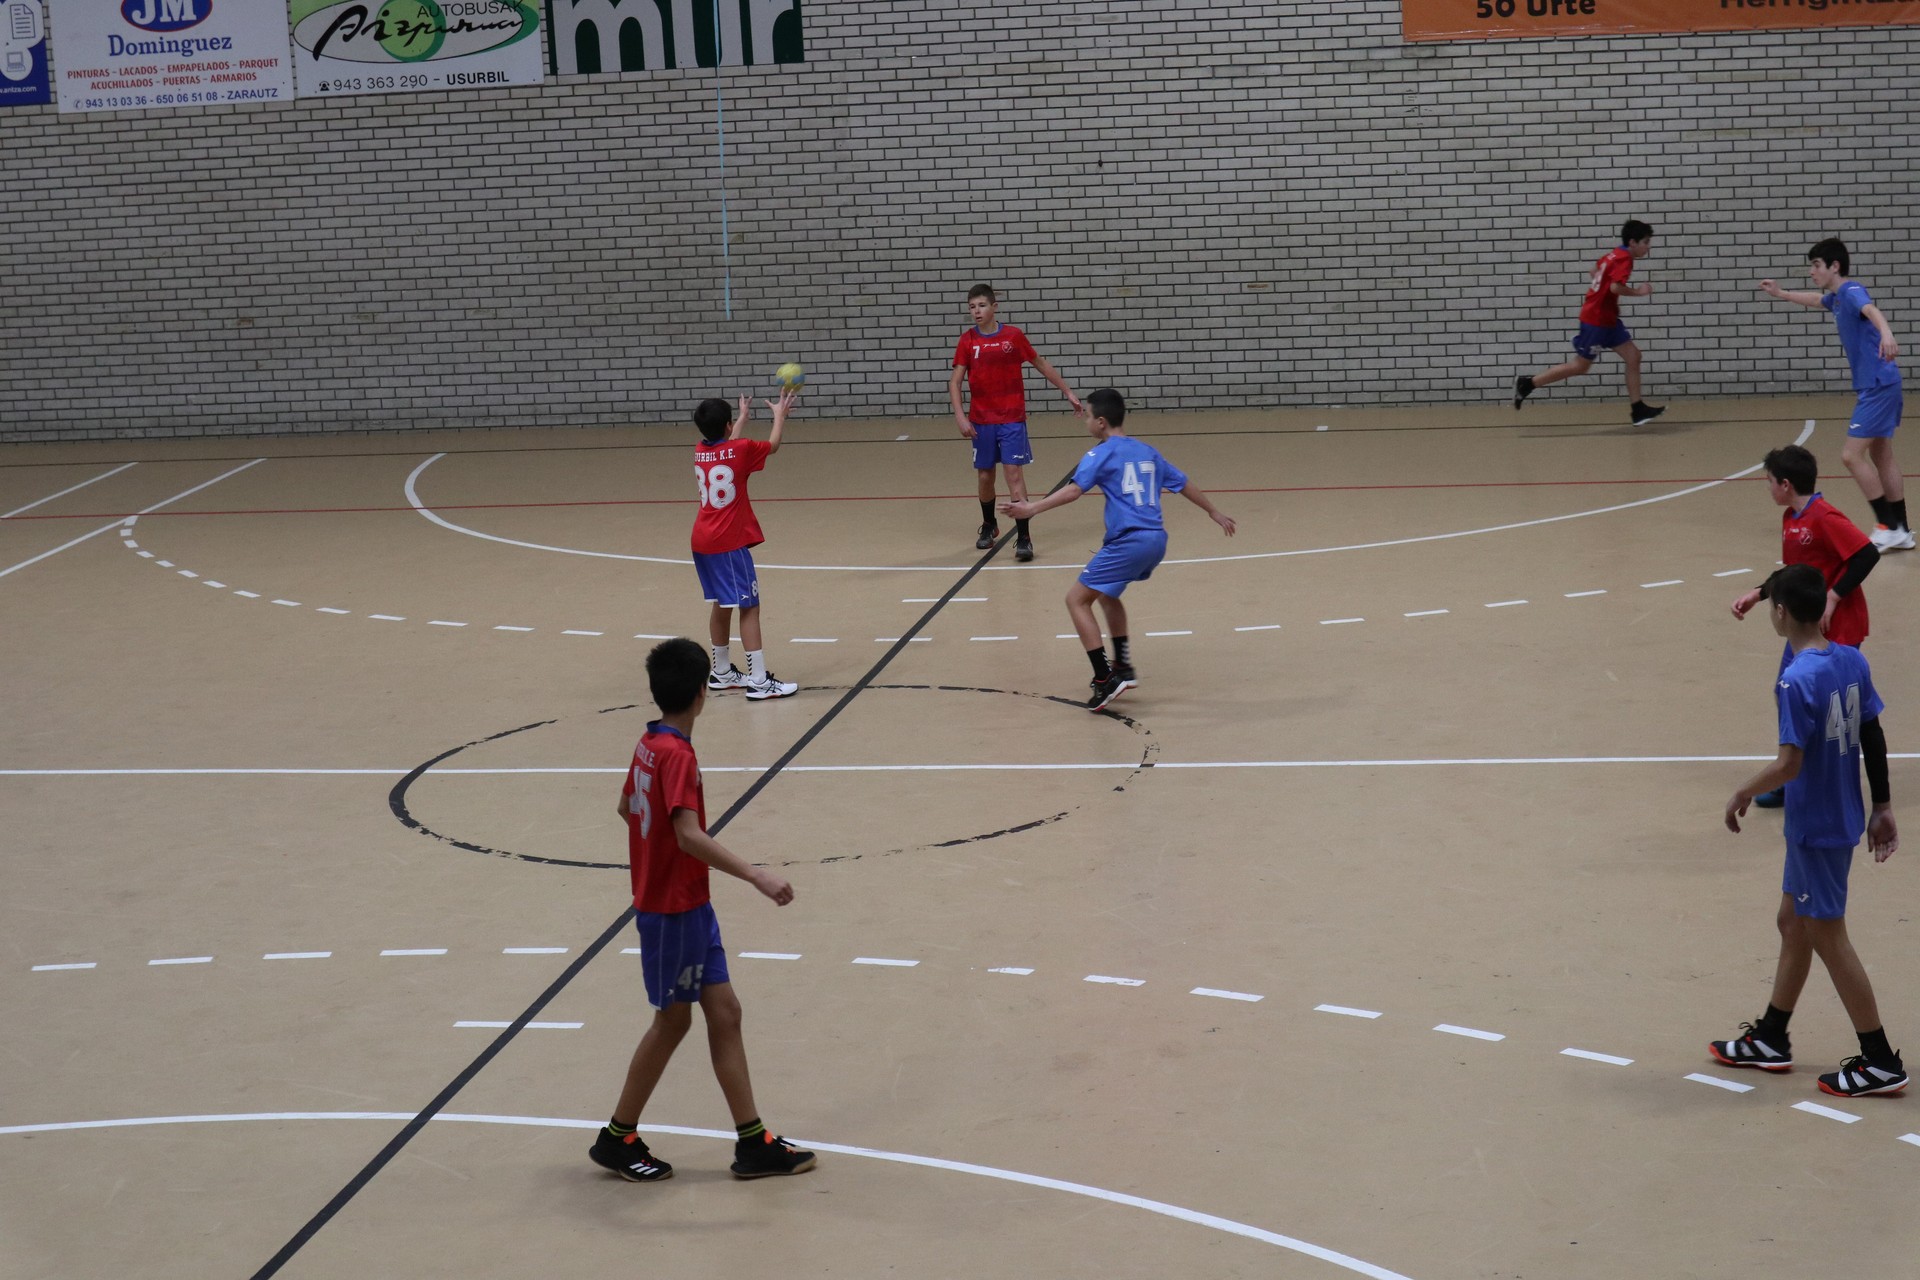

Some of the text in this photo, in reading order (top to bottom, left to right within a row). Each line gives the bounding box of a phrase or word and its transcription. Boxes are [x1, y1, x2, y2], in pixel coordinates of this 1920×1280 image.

[131, 0, 197, 25] JM
[417, 0, 525, 18] AUTOBUSAK
[108, 34, 233, 57] Dominguez
[67, 69, 110, 79] PINTURAS
[119, 65, 158, 76] LACADOS
[167, 61, 230, 73] EMPAPELADOS
[239, 58, 279, 69] PARQUET
[90, 78, 153, 90] ACUCHILLADOS
[163, 75, 201, 86] PUERTAS
[210, 72, 257, 83] ARMARIOS
[333, 78, 362, 91] 943
[366, 76, 395, 89] 363
[399, 74, 428, 88] 290
[446, 71, 510, 86] USURBIL
[85, 98, 104, 108] 943
[106, 97, 118, 107] 13
[120, 96, 133, 106] 03
[135, 95, 147, 105] 36
[156, 94, 174, 104] 650
[176, 93, 189, 102] 06
[191, 92, 203, 102] 51
[206, 91, 218, 101] 08
[227, 88, 278, 100] ZARAUTZ
[972, 345, 980, 359] 7
[720, 448, 736, 460] K.E.
[1121, 461, 1156, 507] 47
[1826, 682, 1860, 757] 44
